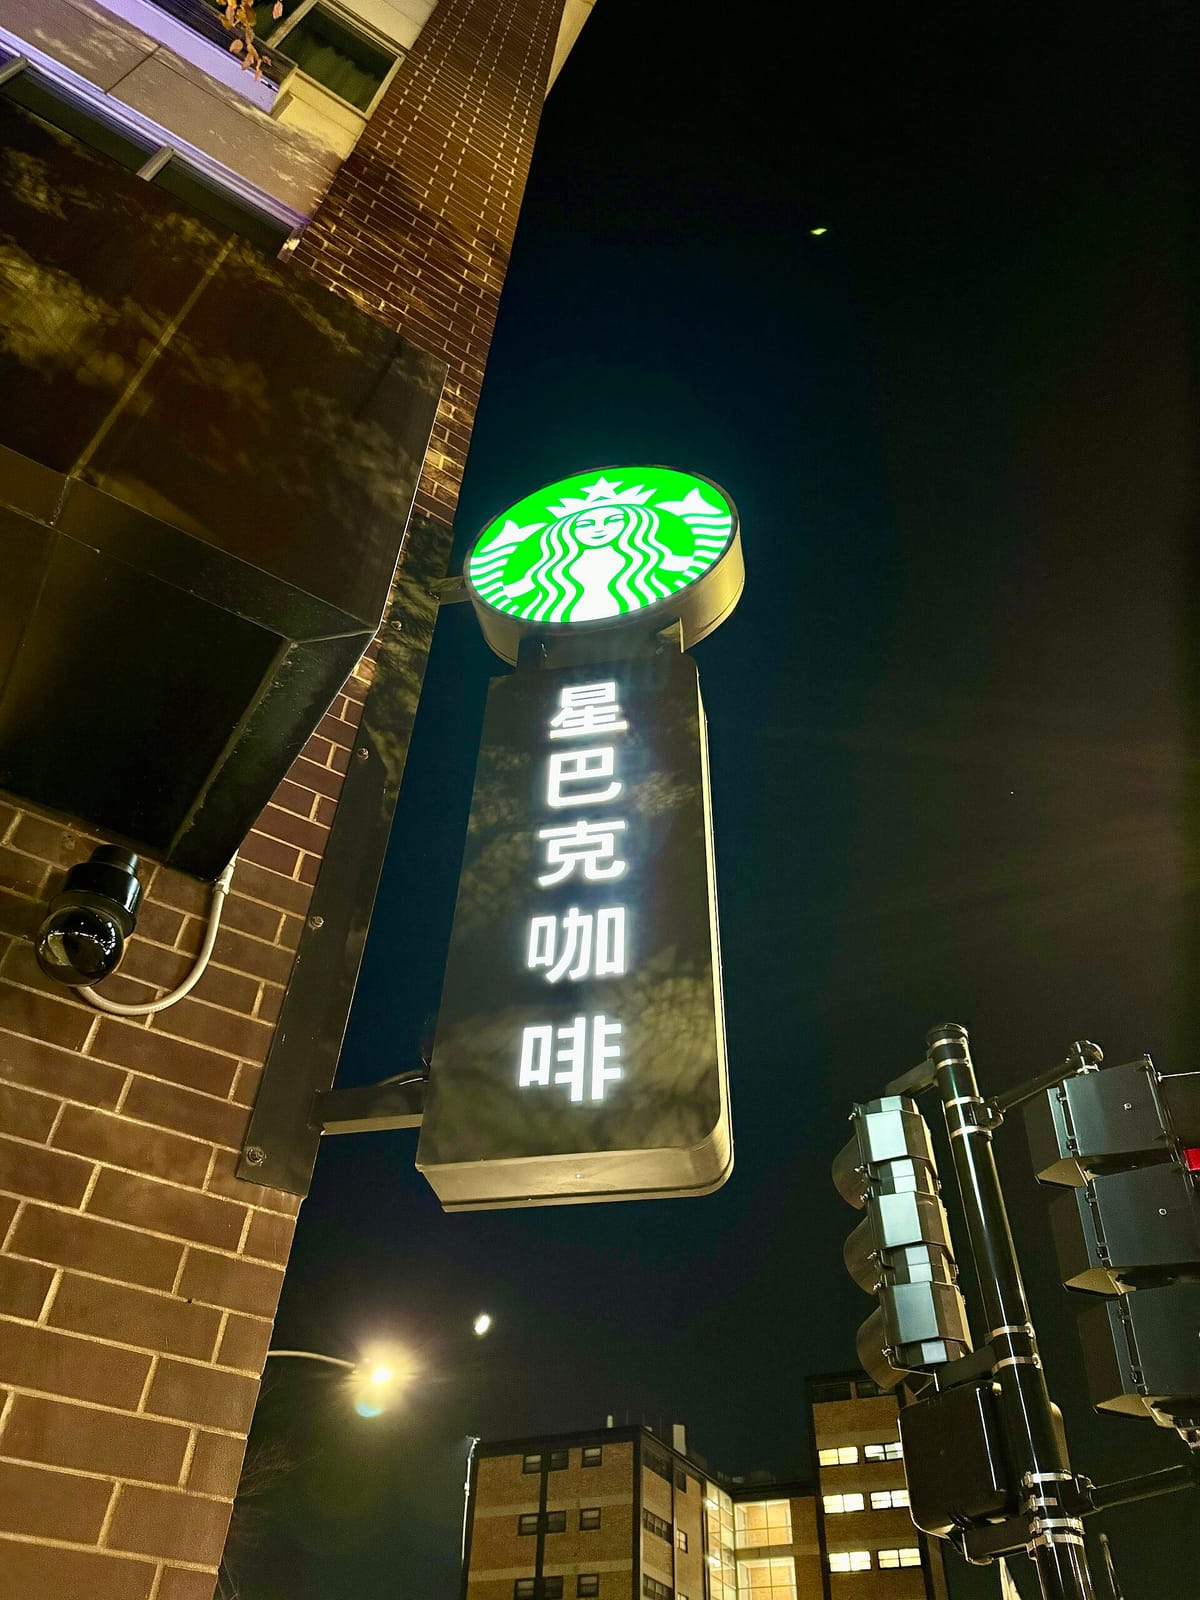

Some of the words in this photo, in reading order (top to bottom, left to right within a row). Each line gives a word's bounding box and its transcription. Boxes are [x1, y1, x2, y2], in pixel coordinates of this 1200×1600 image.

[518, 681, 628, 1102] 星巴克咖啡
